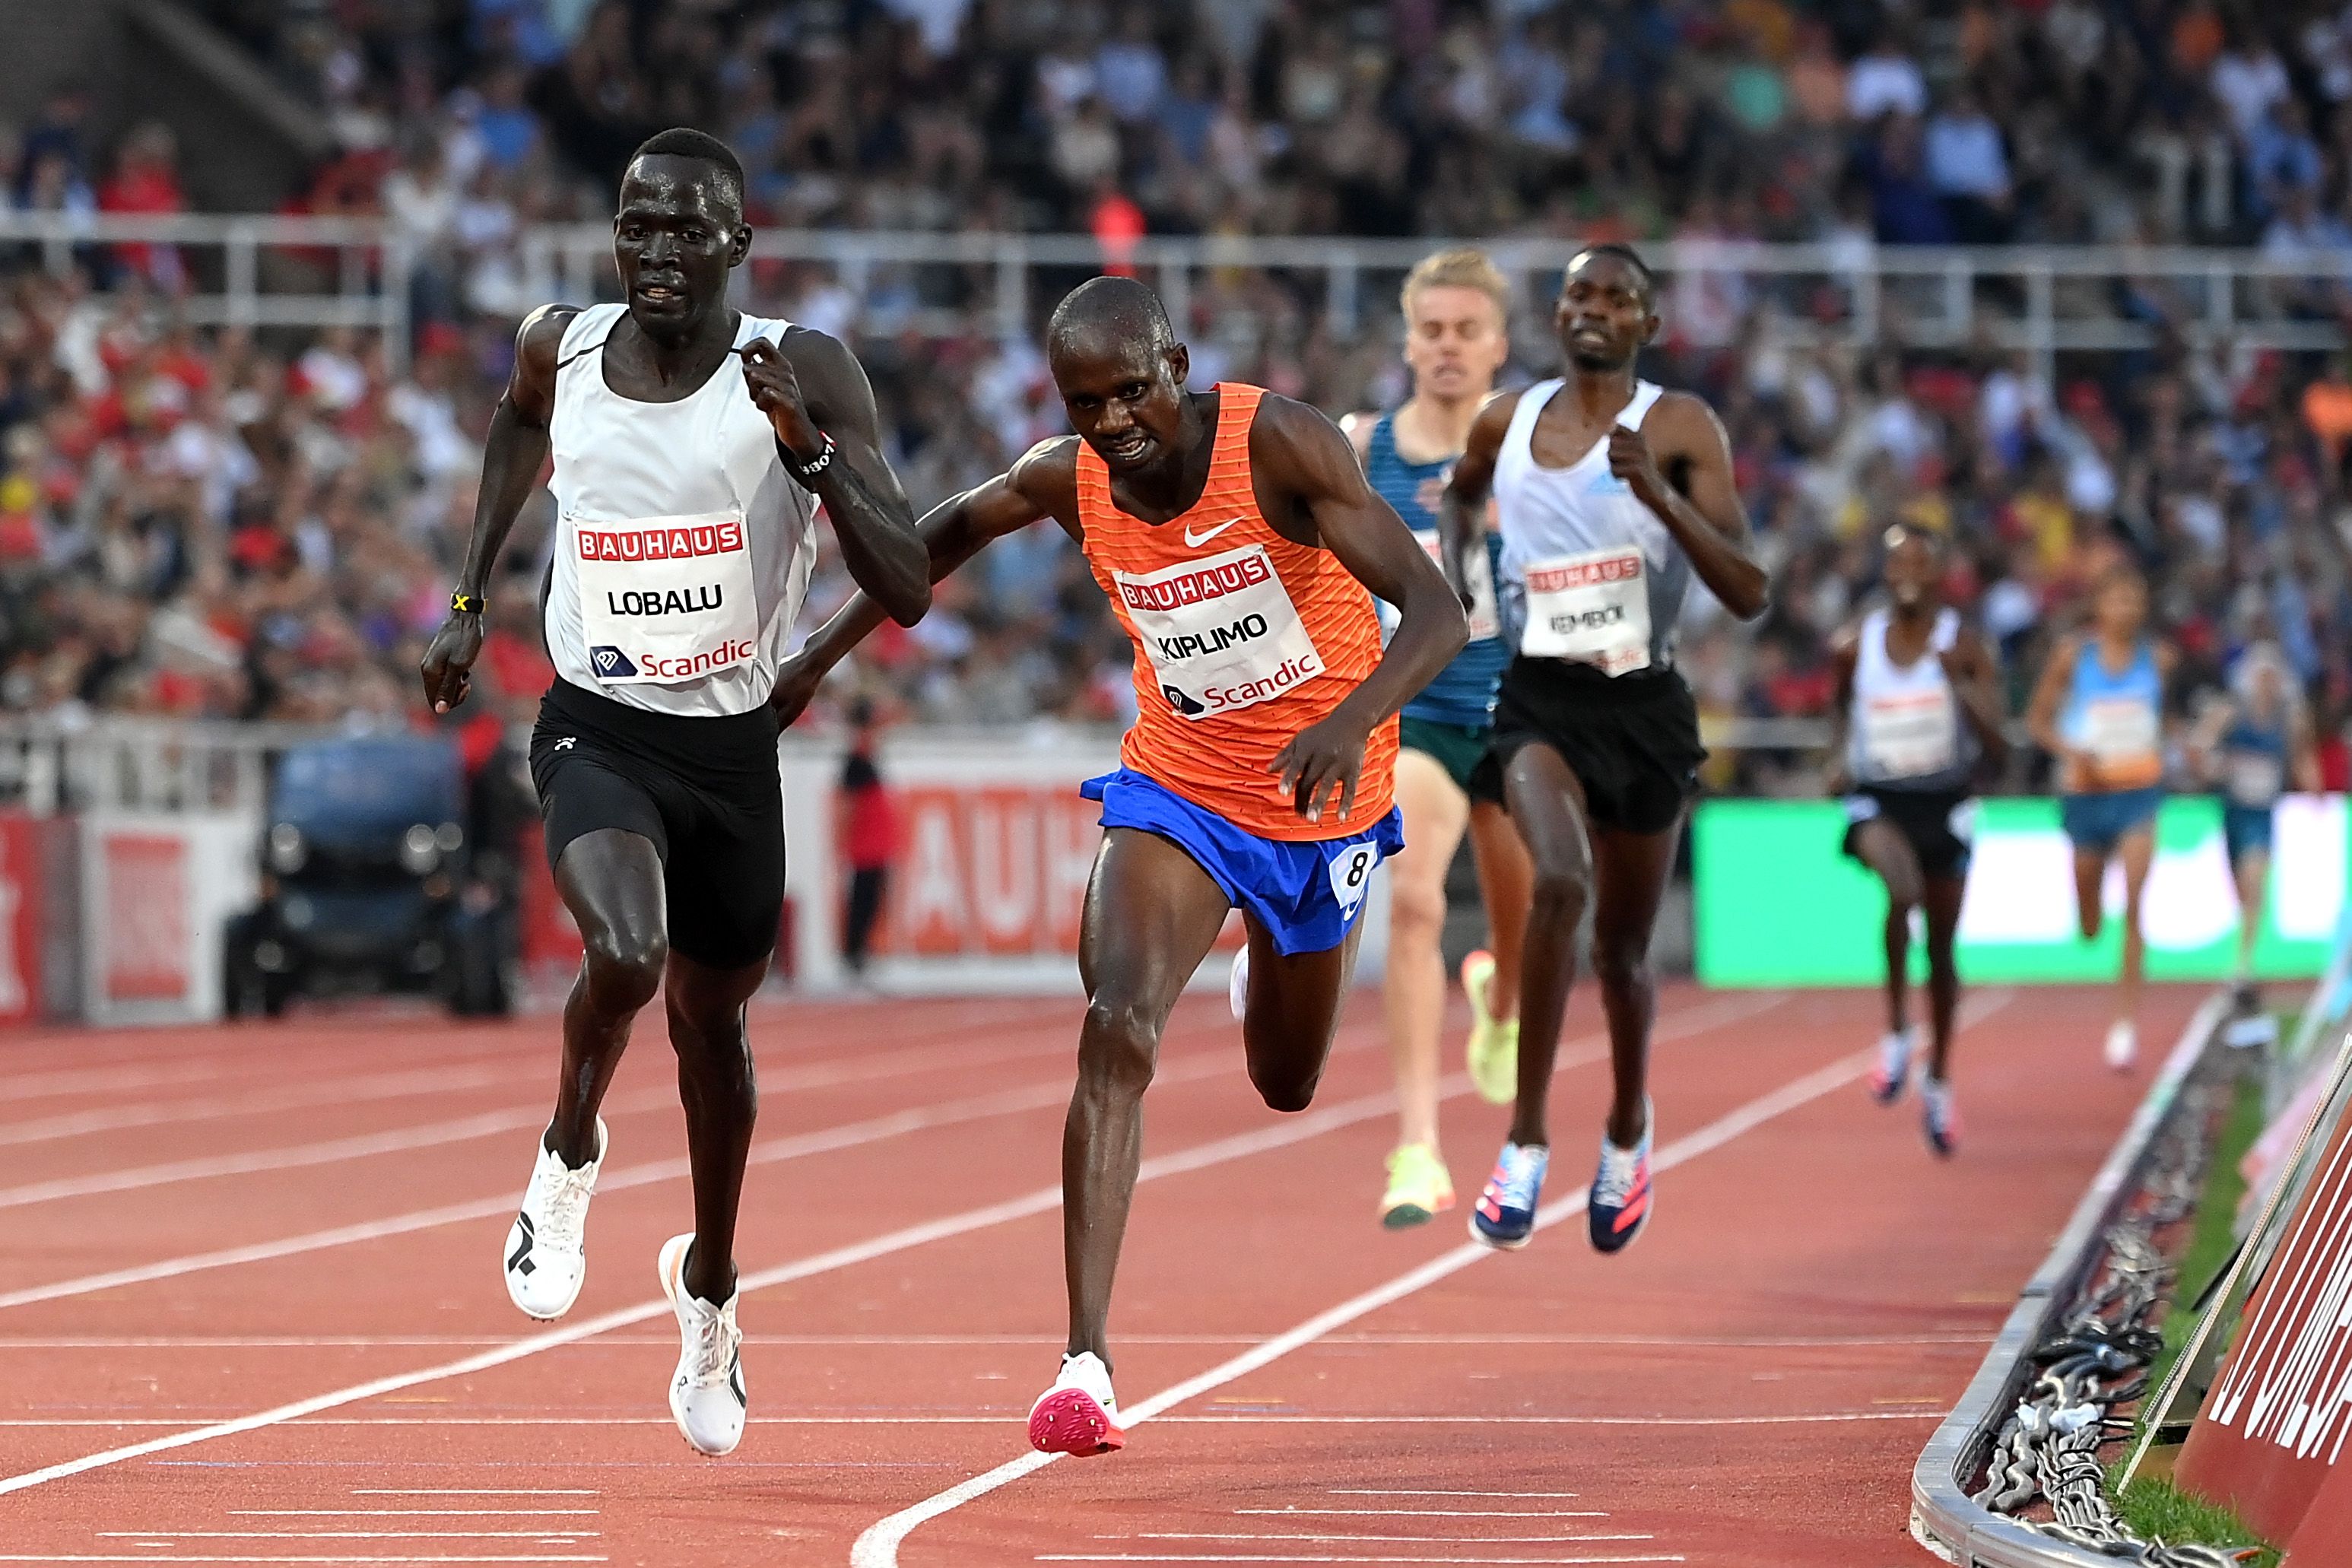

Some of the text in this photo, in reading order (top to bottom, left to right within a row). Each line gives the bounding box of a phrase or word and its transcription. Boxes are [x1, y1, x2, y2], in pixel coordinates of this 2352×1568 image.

[579, 523, 742, 560] BAUHAUS
[608, 584, 722, 616] LOBALU
[1122, 556, 1269, 610] BAUHAUS
[1157, 613, 1268, 659] KIPLIMO
[641, 639, 752, 678] Scandic
[1204, 654, 1316, 708] Scandic
[1347, 852, 1368, 887] 8
